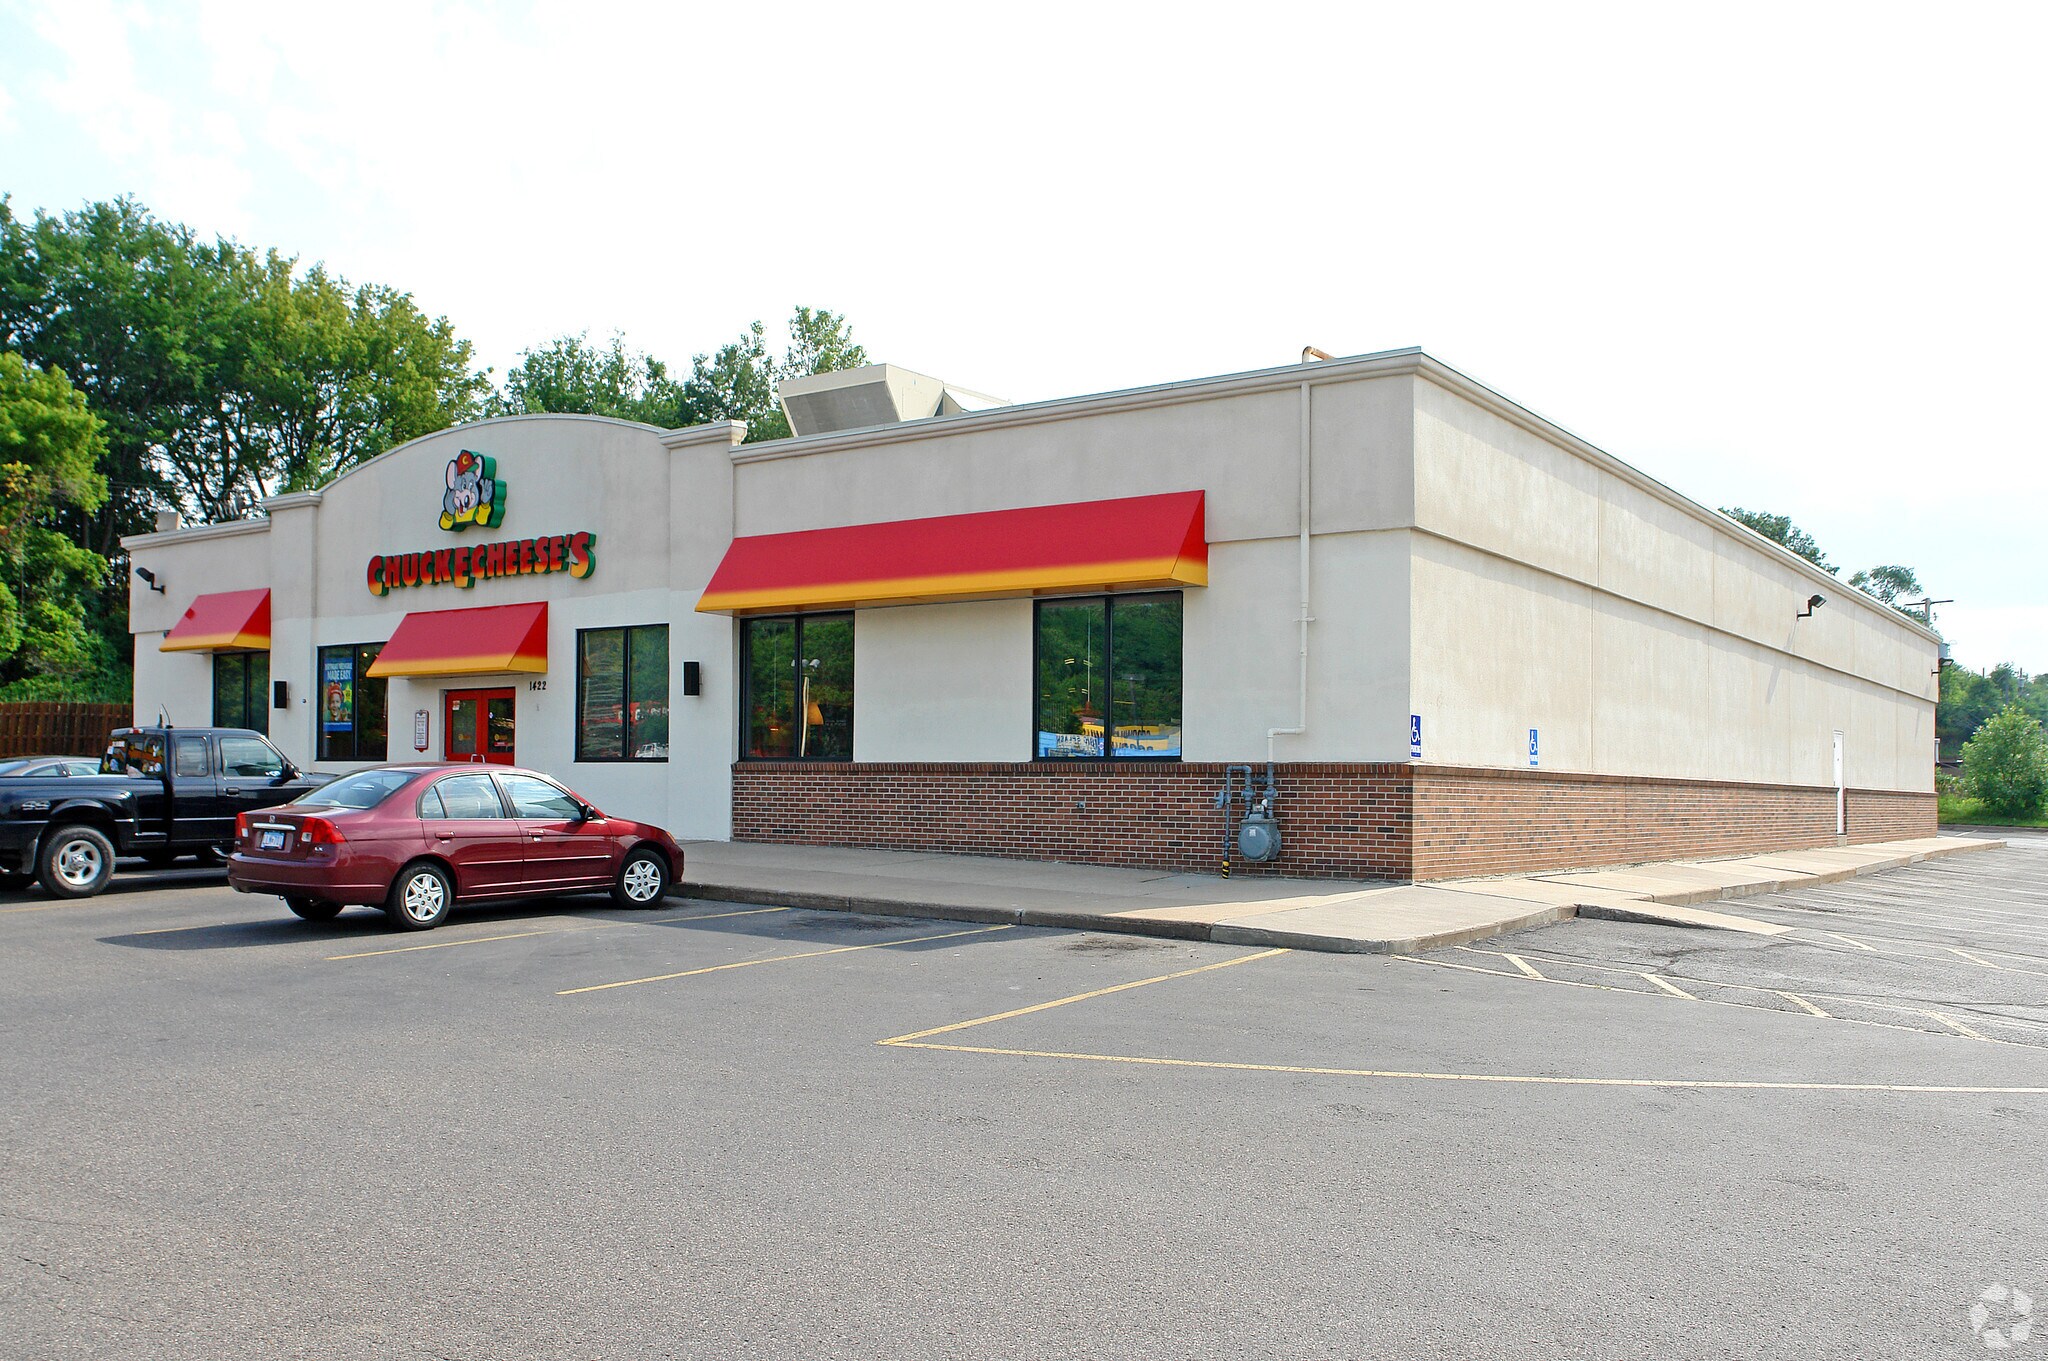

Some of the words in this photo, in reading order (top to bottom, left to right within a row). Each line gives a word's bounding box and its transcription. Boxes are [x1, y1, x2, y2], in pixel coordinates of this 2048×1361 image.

[367, 548, 453, 596] CHUCK
[471, 531, 596, 580] CHEESE'S
[529, 681, 547, 691] 1422
